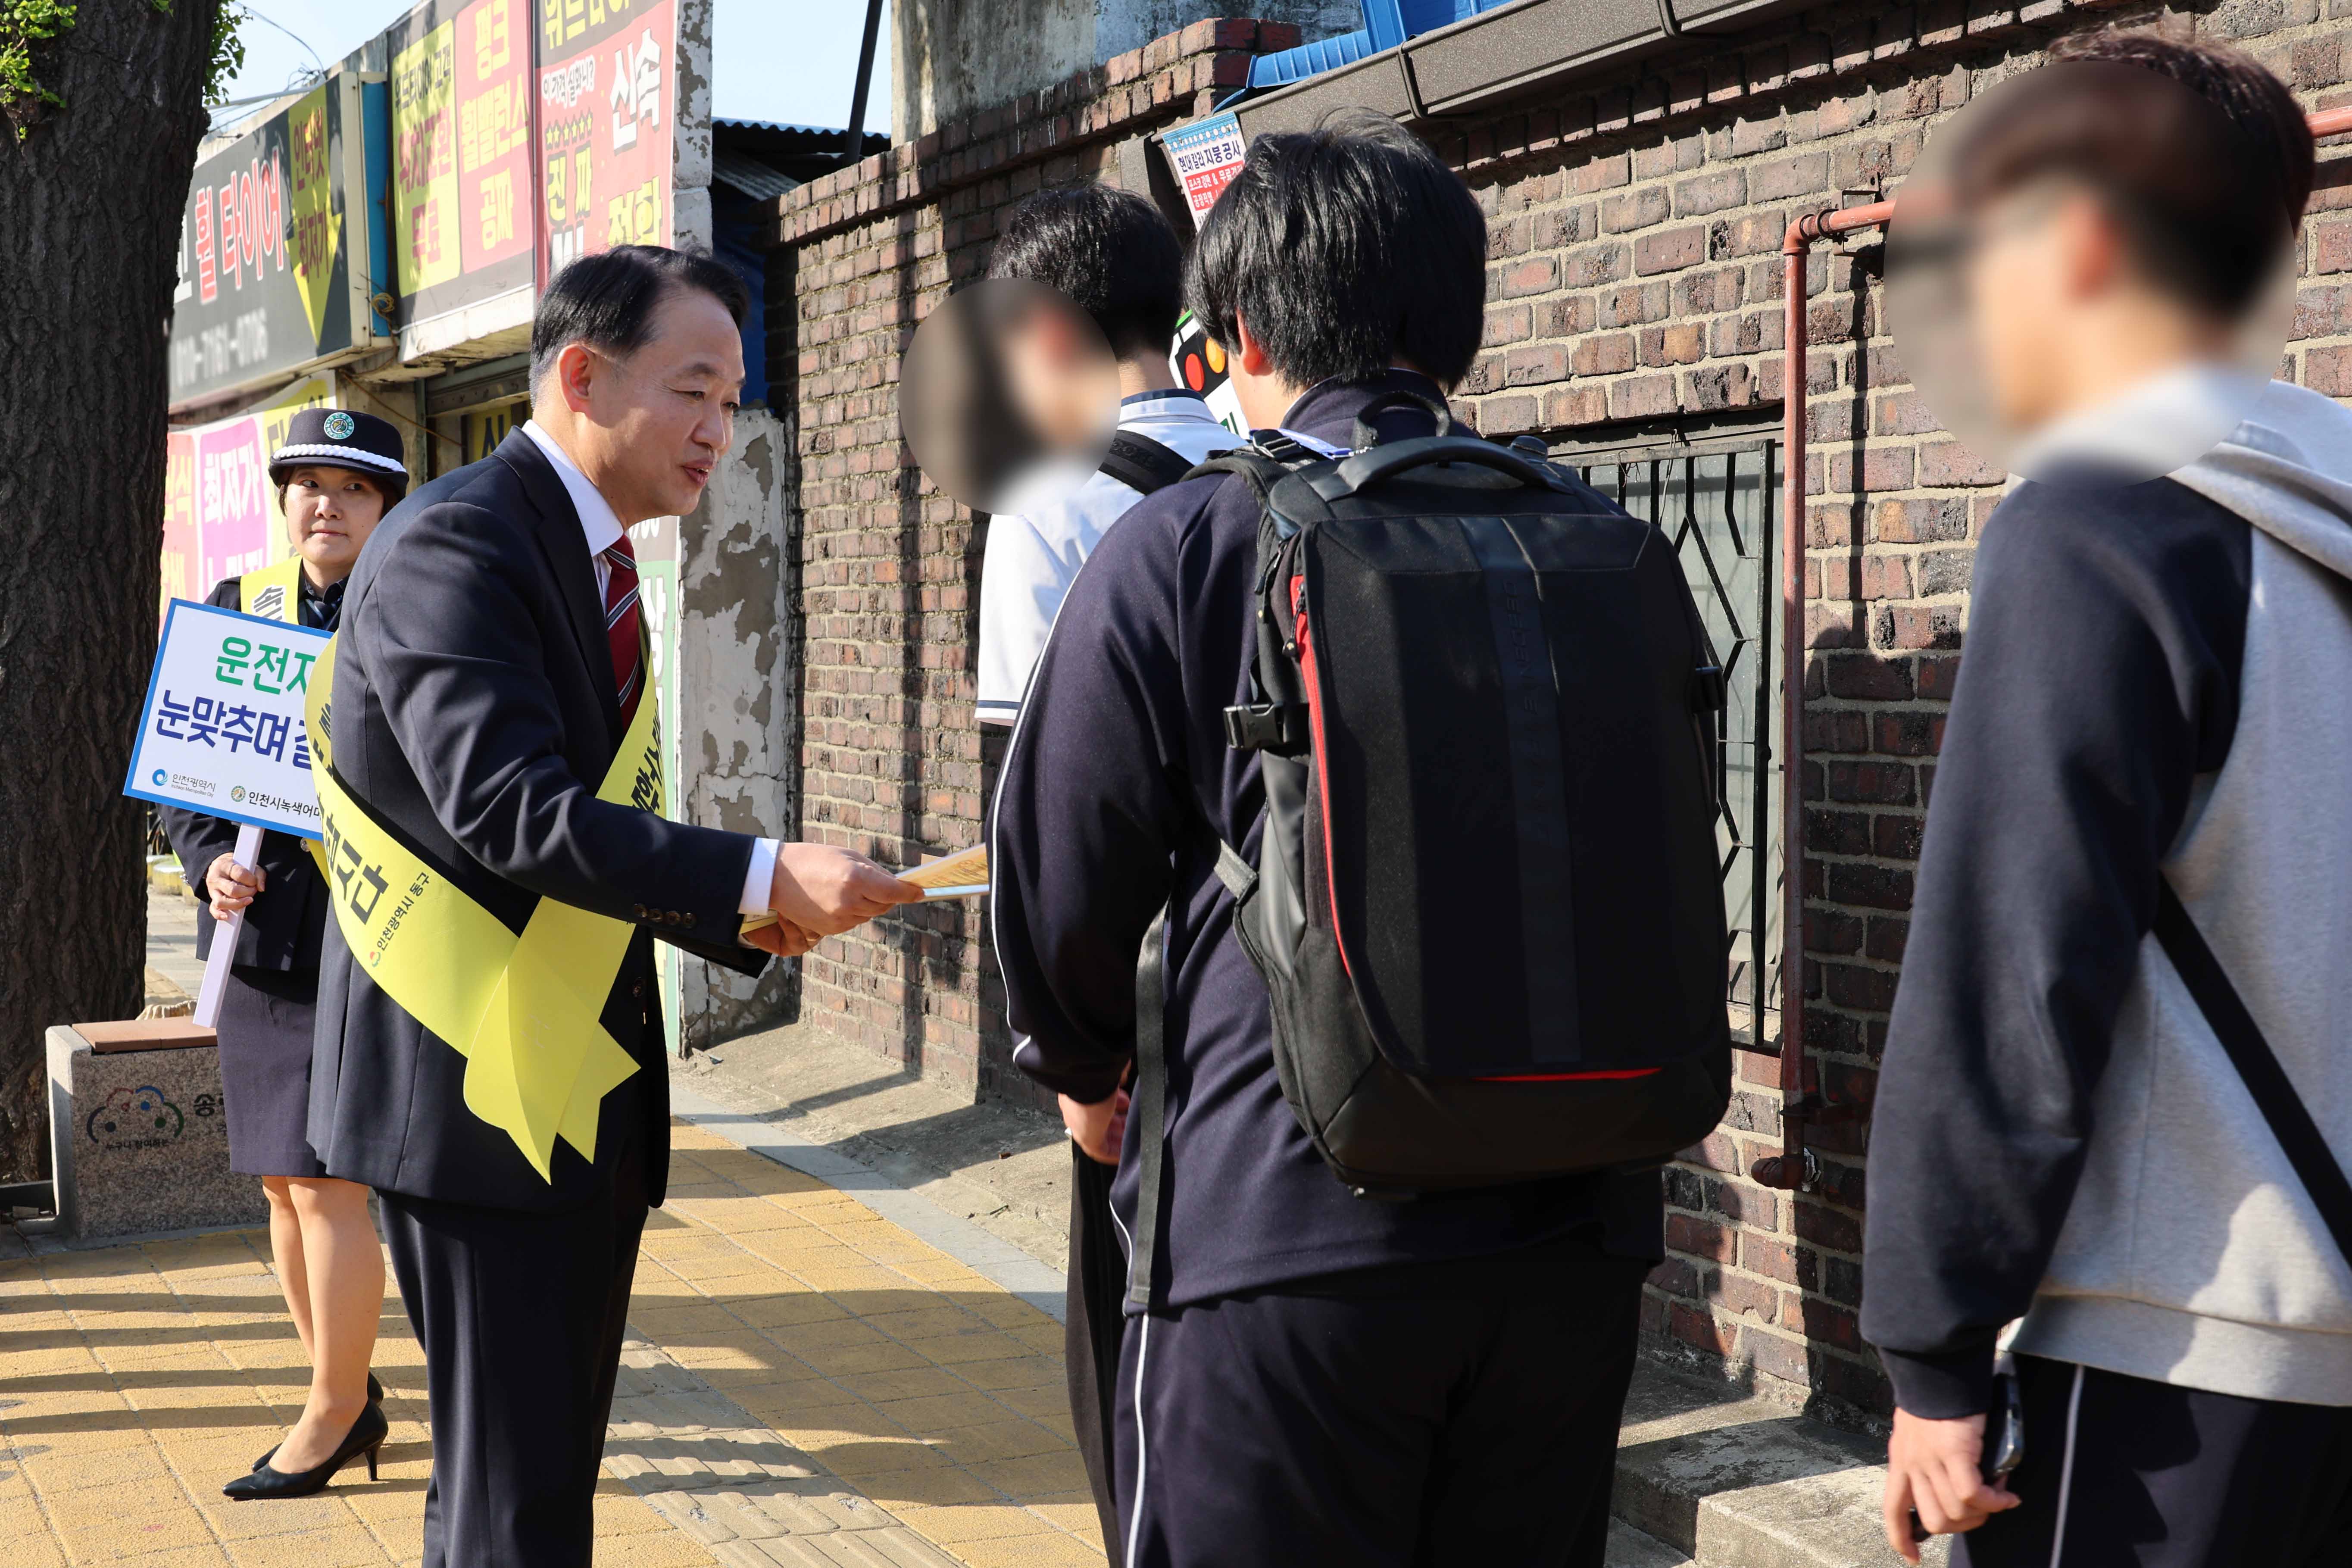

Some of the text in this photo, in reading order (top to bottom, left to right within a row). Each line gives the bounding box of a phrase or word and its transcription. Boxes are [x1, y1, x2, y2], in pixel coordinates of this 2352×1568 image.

[461, 73, 529, 173] 휠밸런스
[610, 27, 661, 150] 신속
[220, 147, 284, 290] 타이어
[412, 199, 441, 269] 무료
[480, 167, 513, 250] 공짜
[204, 441, 260, 525] 최저가
[156, 689, 291, 762] 눈맞추며
[172, 774, 216, 792] 인천광역시
[185, 787, 206, 796] Metropolitan
[377, 872, 430, 951] 인천광역시 동구
